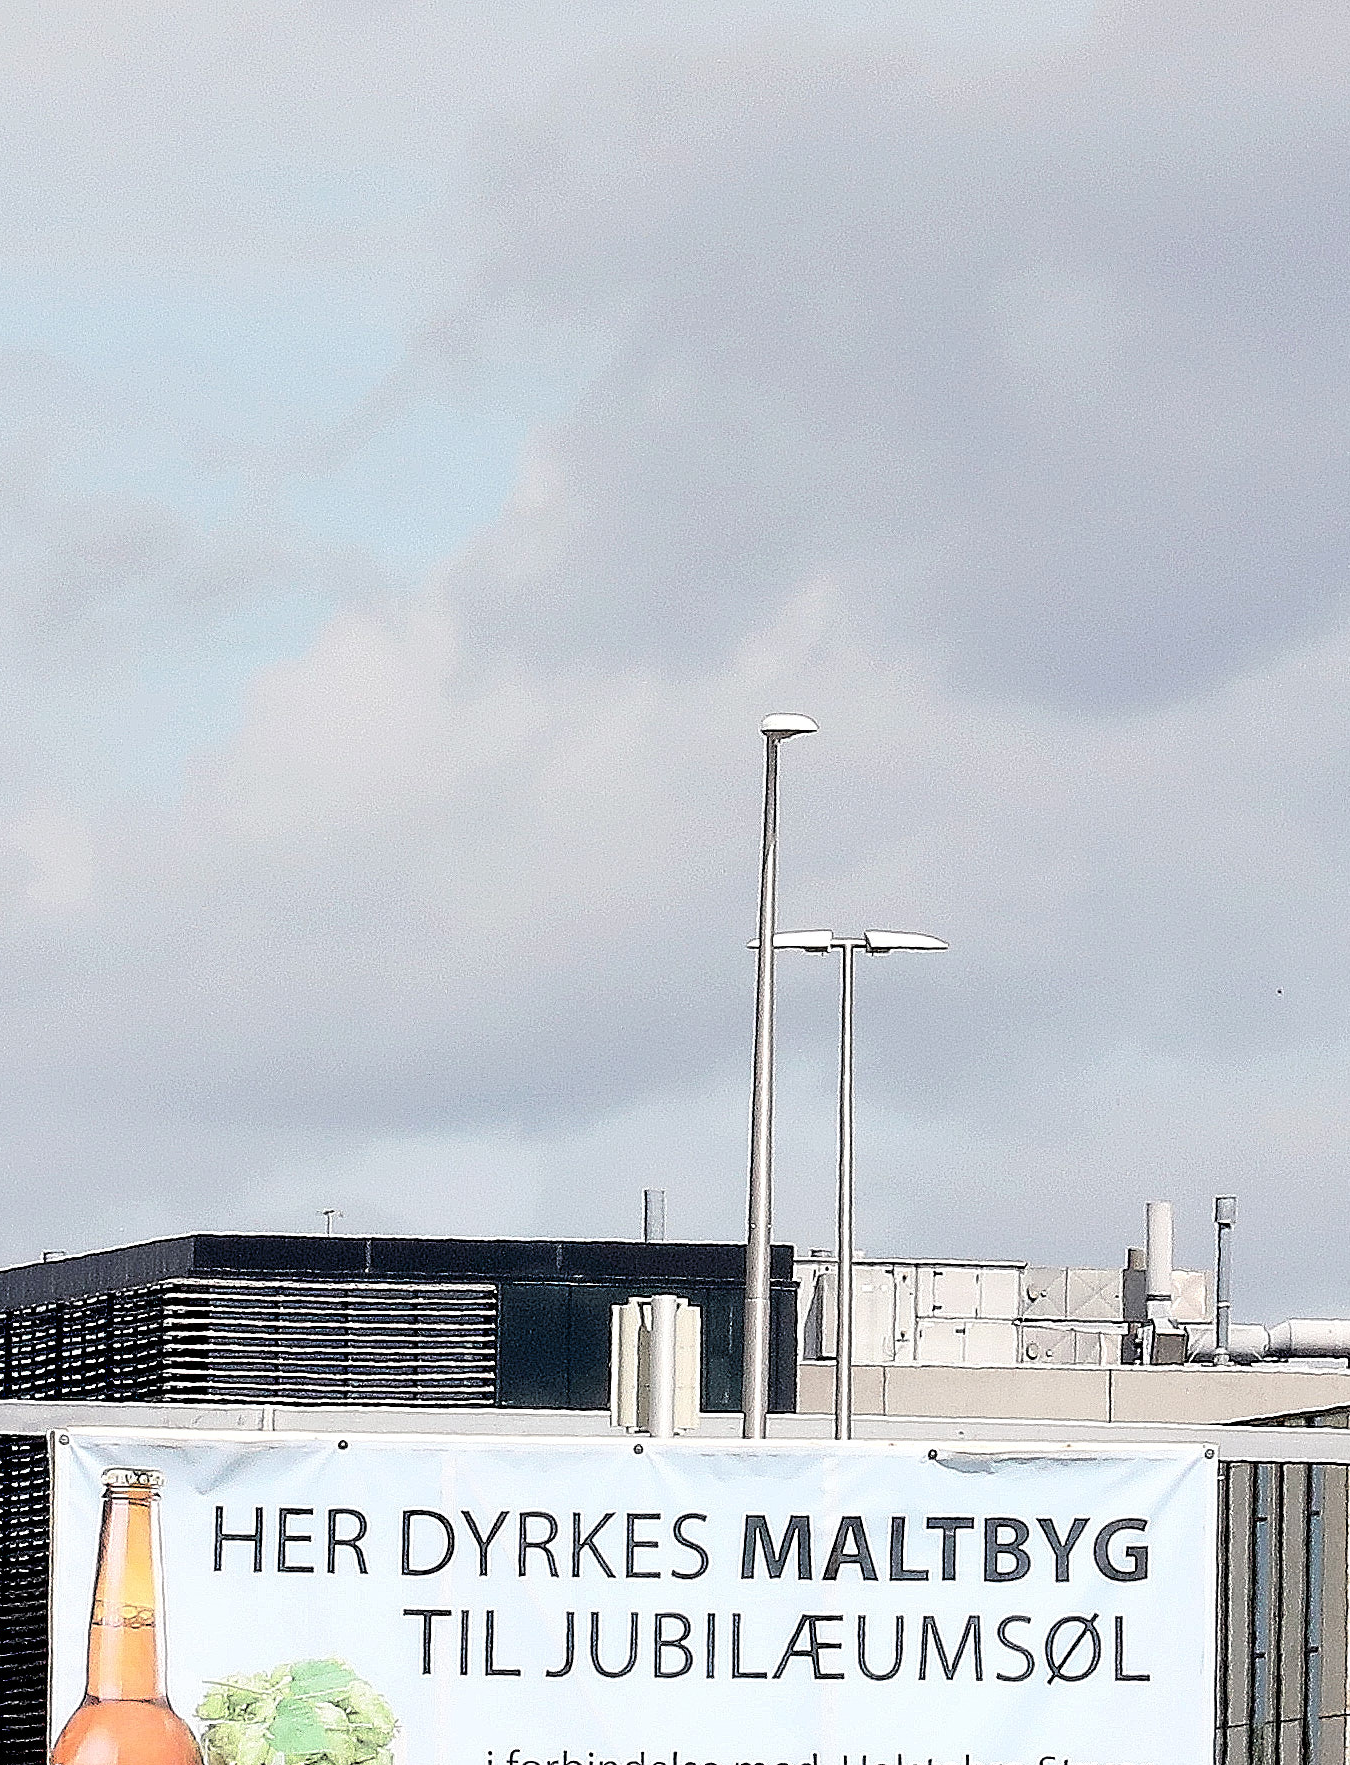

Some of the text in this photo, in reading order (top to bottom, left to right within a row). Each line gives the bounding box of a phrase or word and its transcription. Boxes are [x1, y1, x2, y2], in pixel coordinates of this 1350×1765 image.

[213, 1505, 1150, 1583] HER DYRKES MALTBYG
[402, 1608, 1151, 1686] TIL JUBILÆUMSØL
